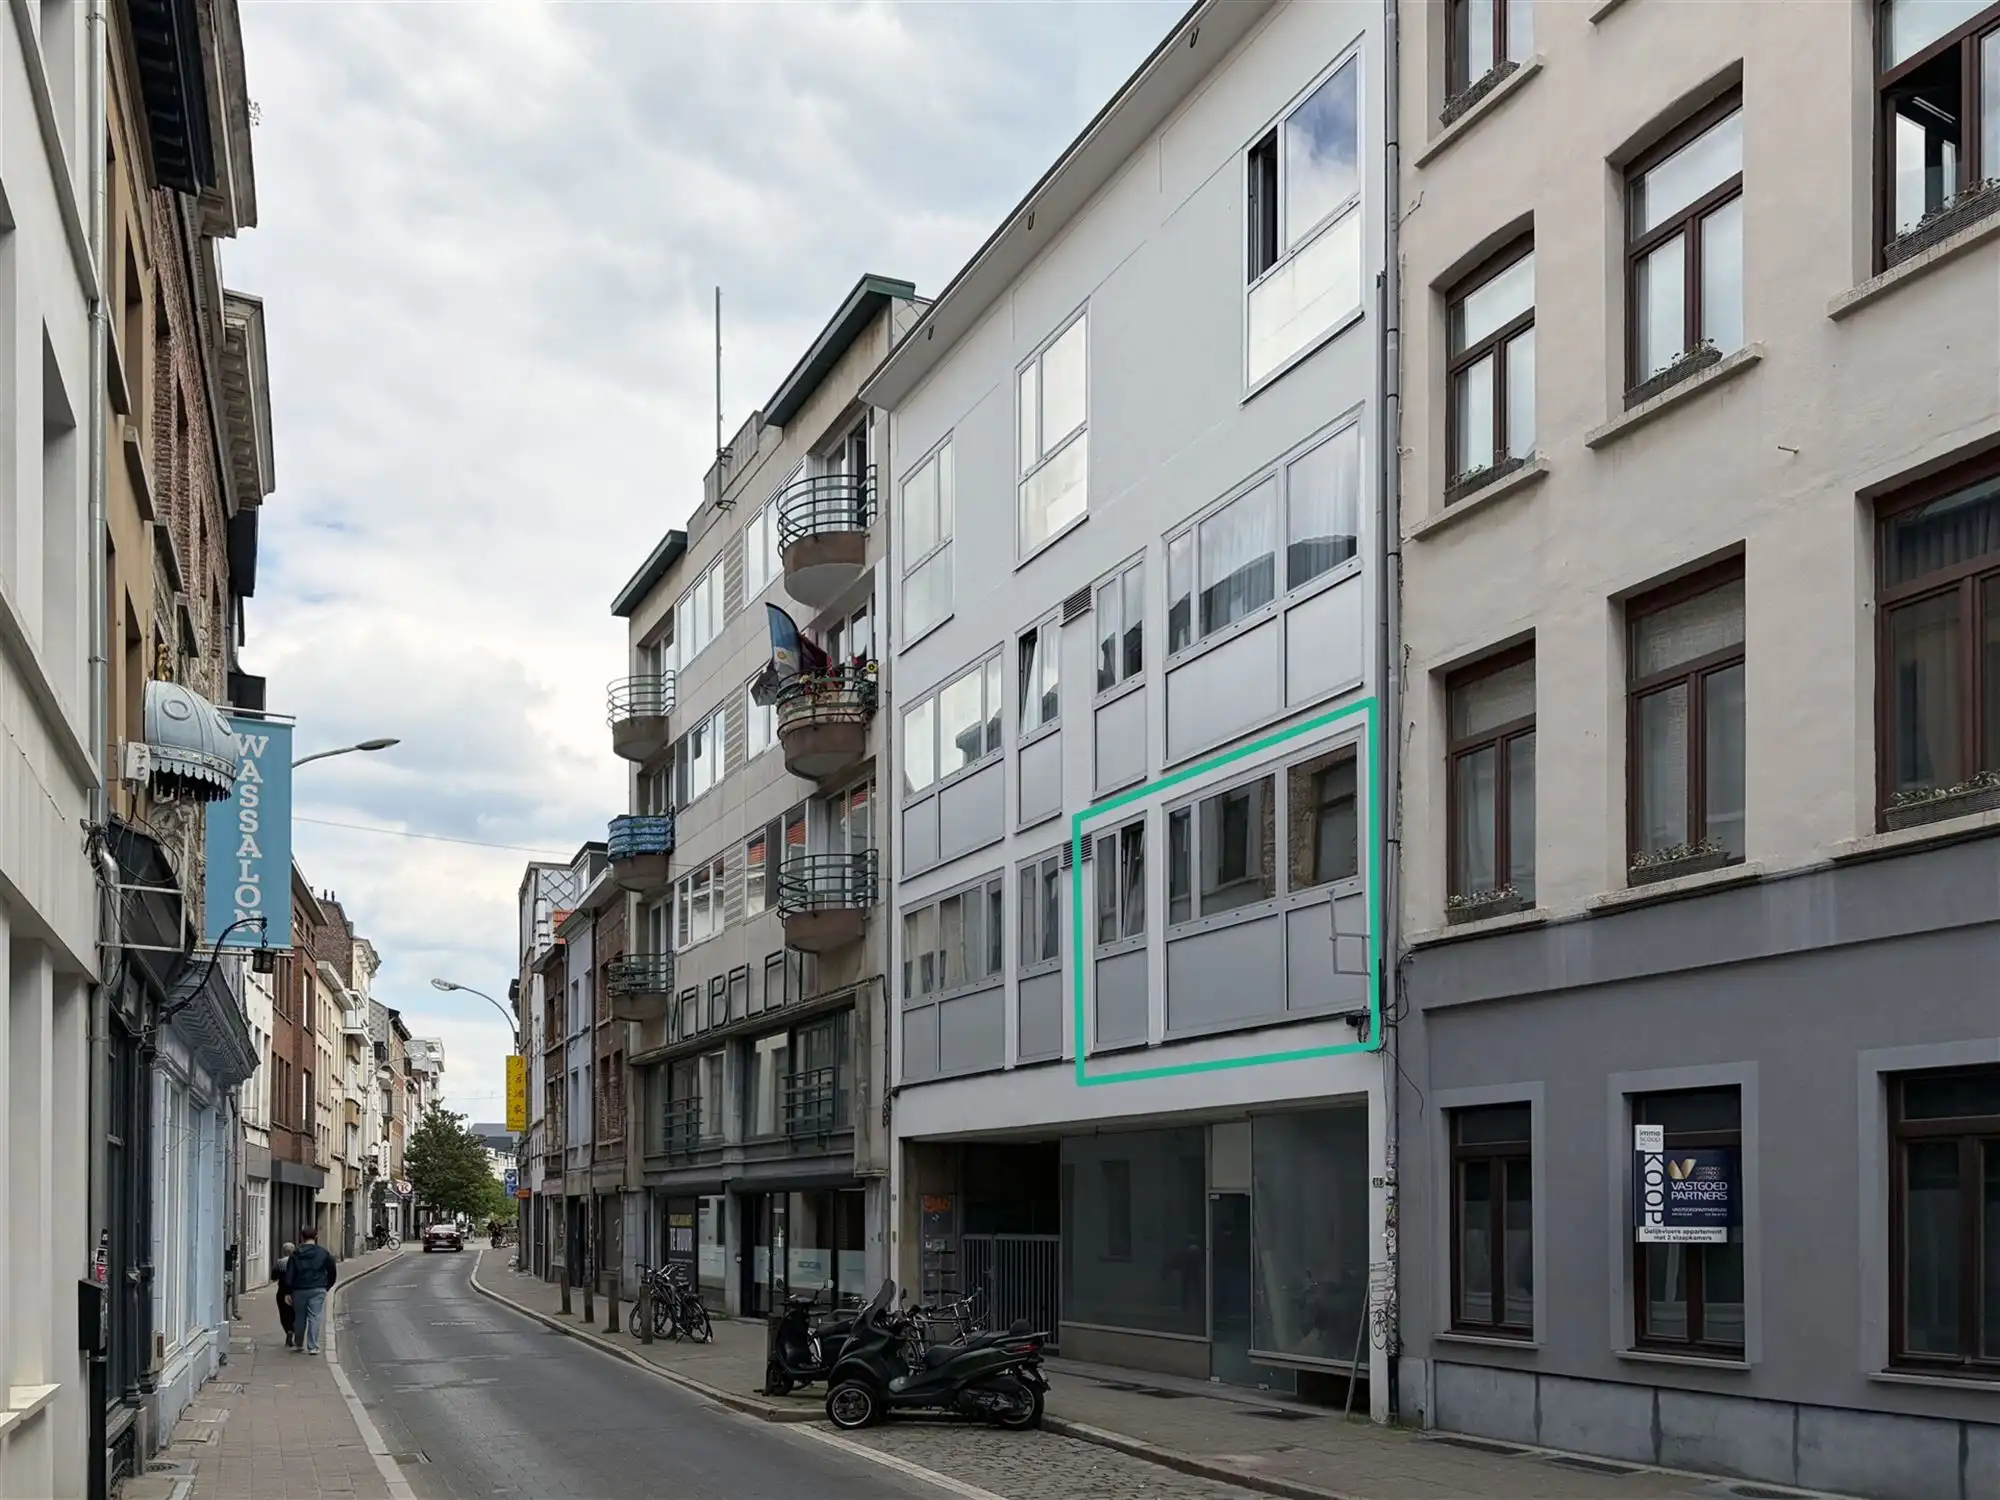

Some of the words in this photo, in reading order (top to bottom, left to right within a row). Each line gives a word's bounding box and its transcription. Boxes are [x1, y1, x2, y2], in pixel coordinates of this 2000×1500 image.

[233, 733, 269, 933] WASSALON
[667, 949, 803, 1044] MEUBELEN
[1644, 1152, 1664, 1225] KOOP
[1671, 1181, 1728, 1191] VASTGOED
[1671, 1191, 1728, 1201] PARTNERS
[1683, 1228, 1722, 1236] appartement
